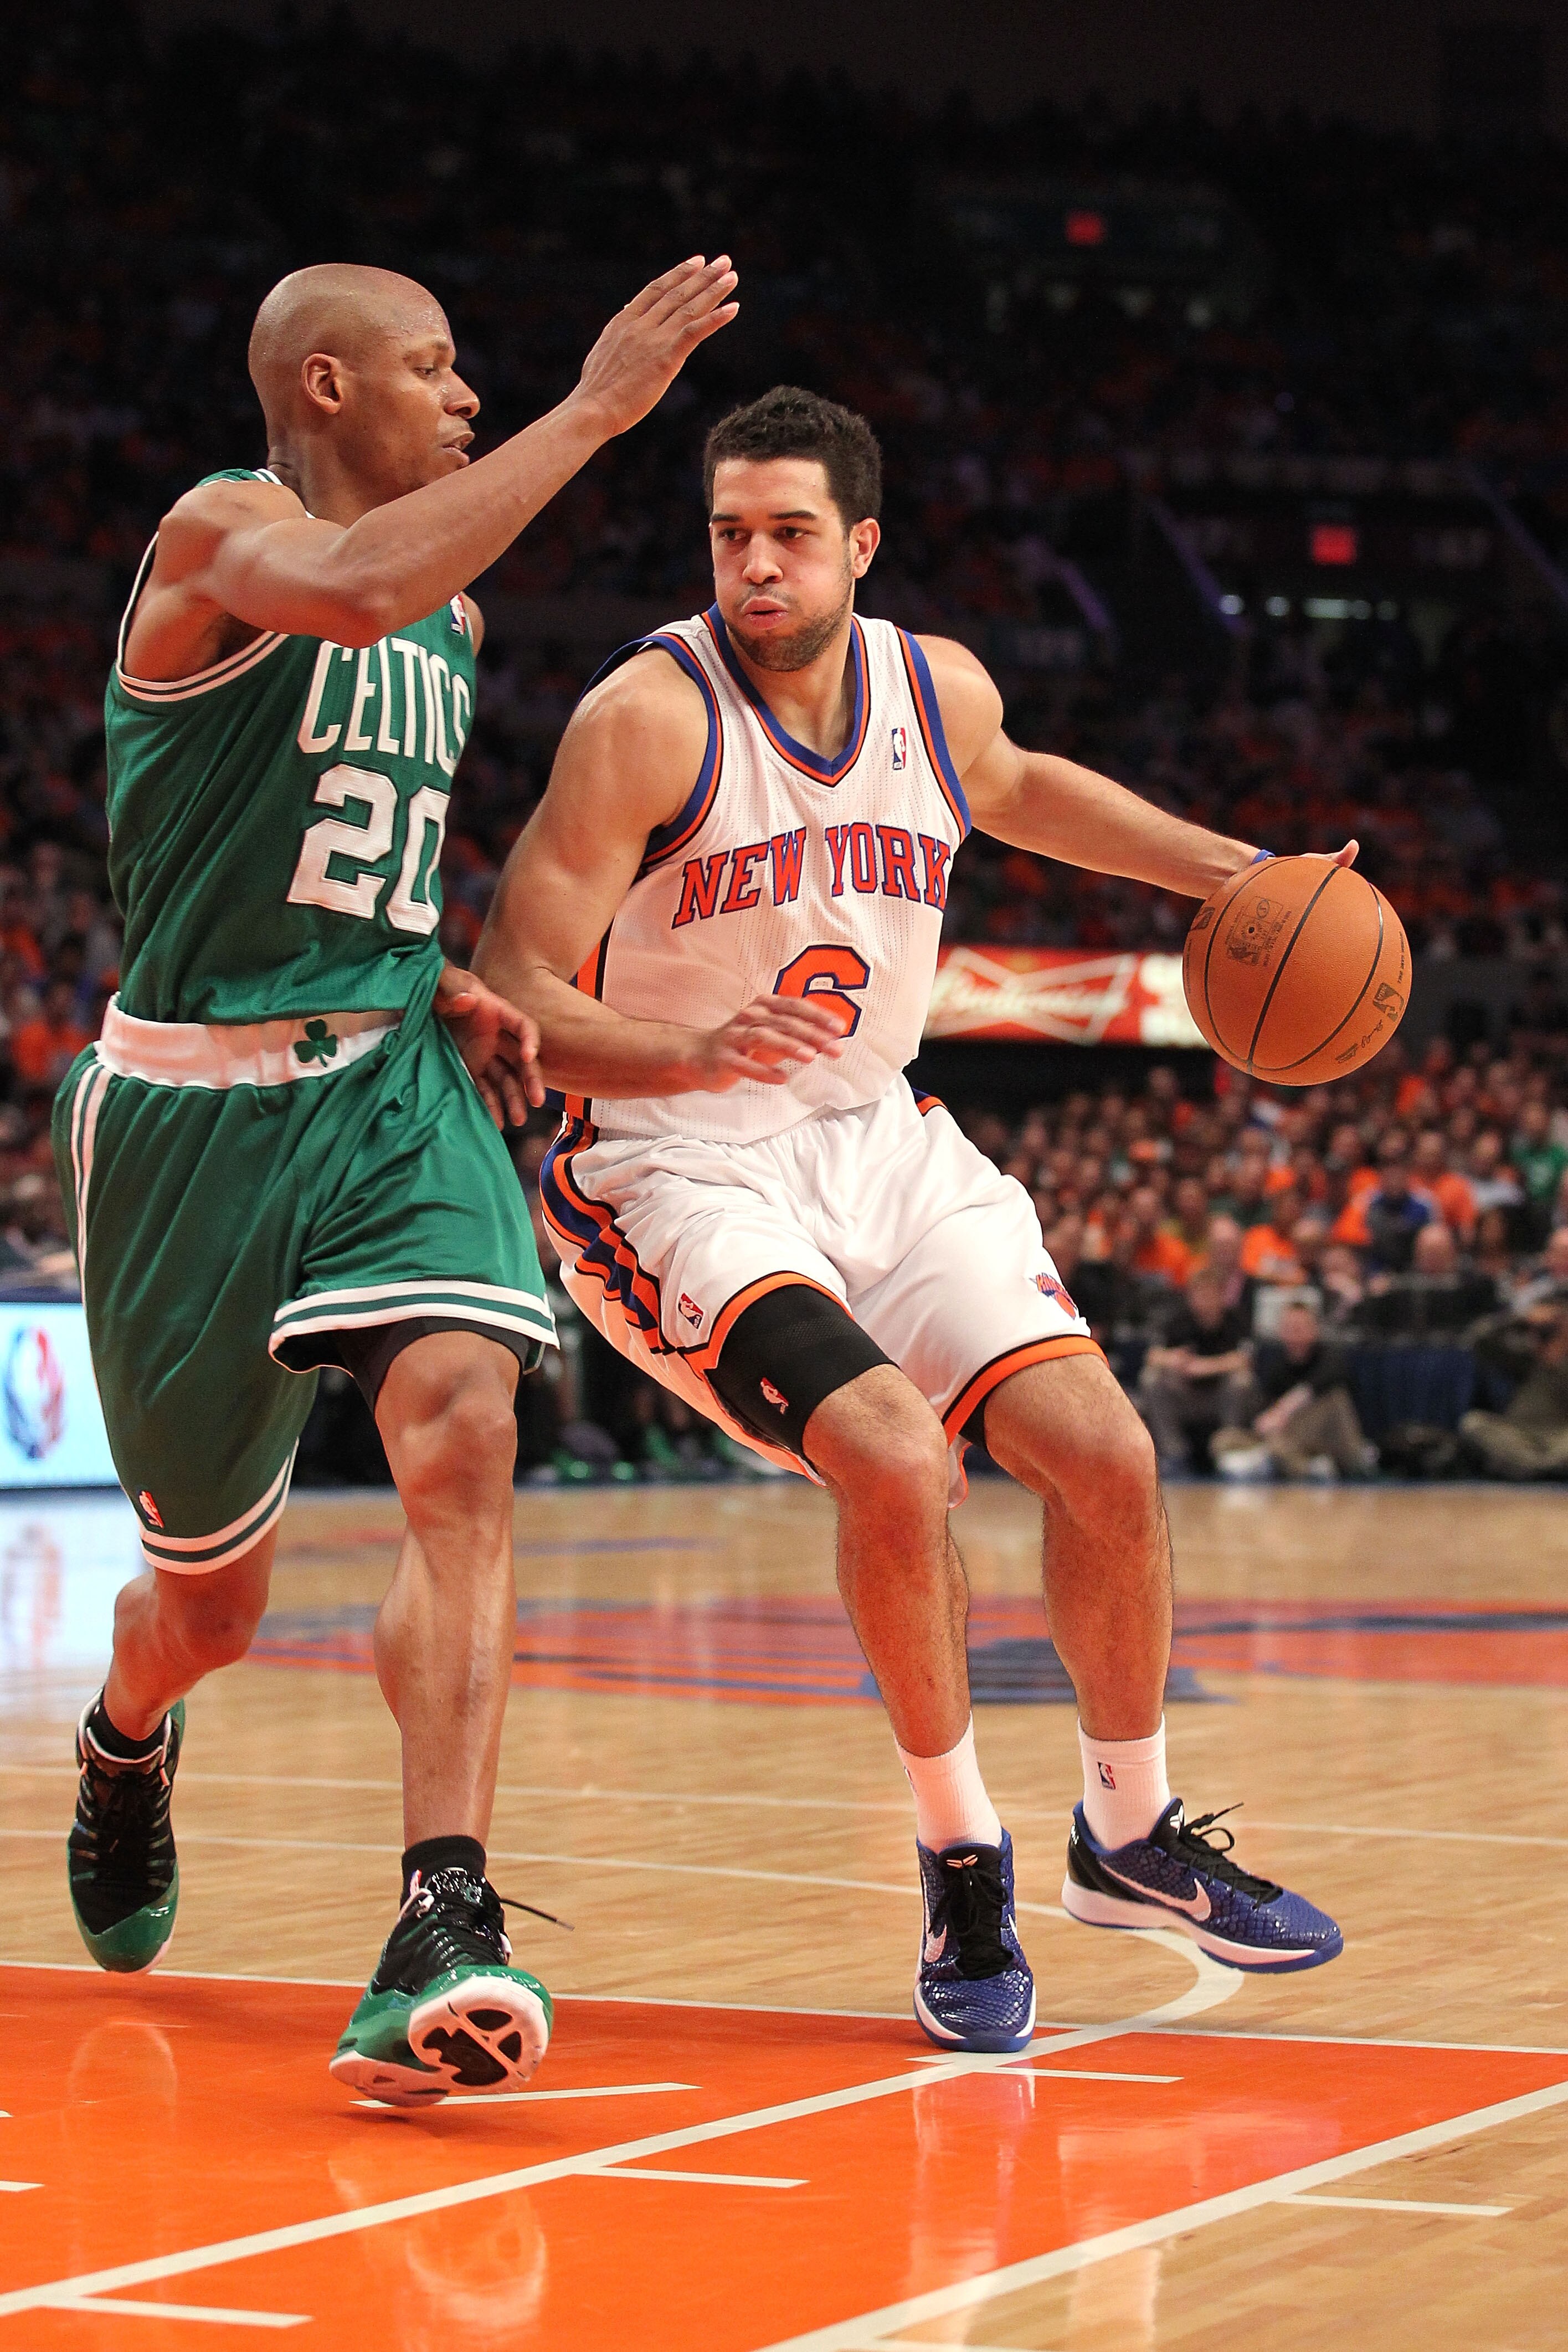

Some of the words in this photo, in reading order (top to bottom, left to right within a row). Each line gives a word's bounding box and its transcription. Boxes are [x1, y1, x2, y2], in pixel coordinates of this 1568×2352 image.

[297, 637, 470, 777] CELTICS
[286, 763, 450, 936] 20
[672, 826, 806, 929] NEW
[825, 822, 952, 914] YORK
[772, 944, 870, 1054] 6
